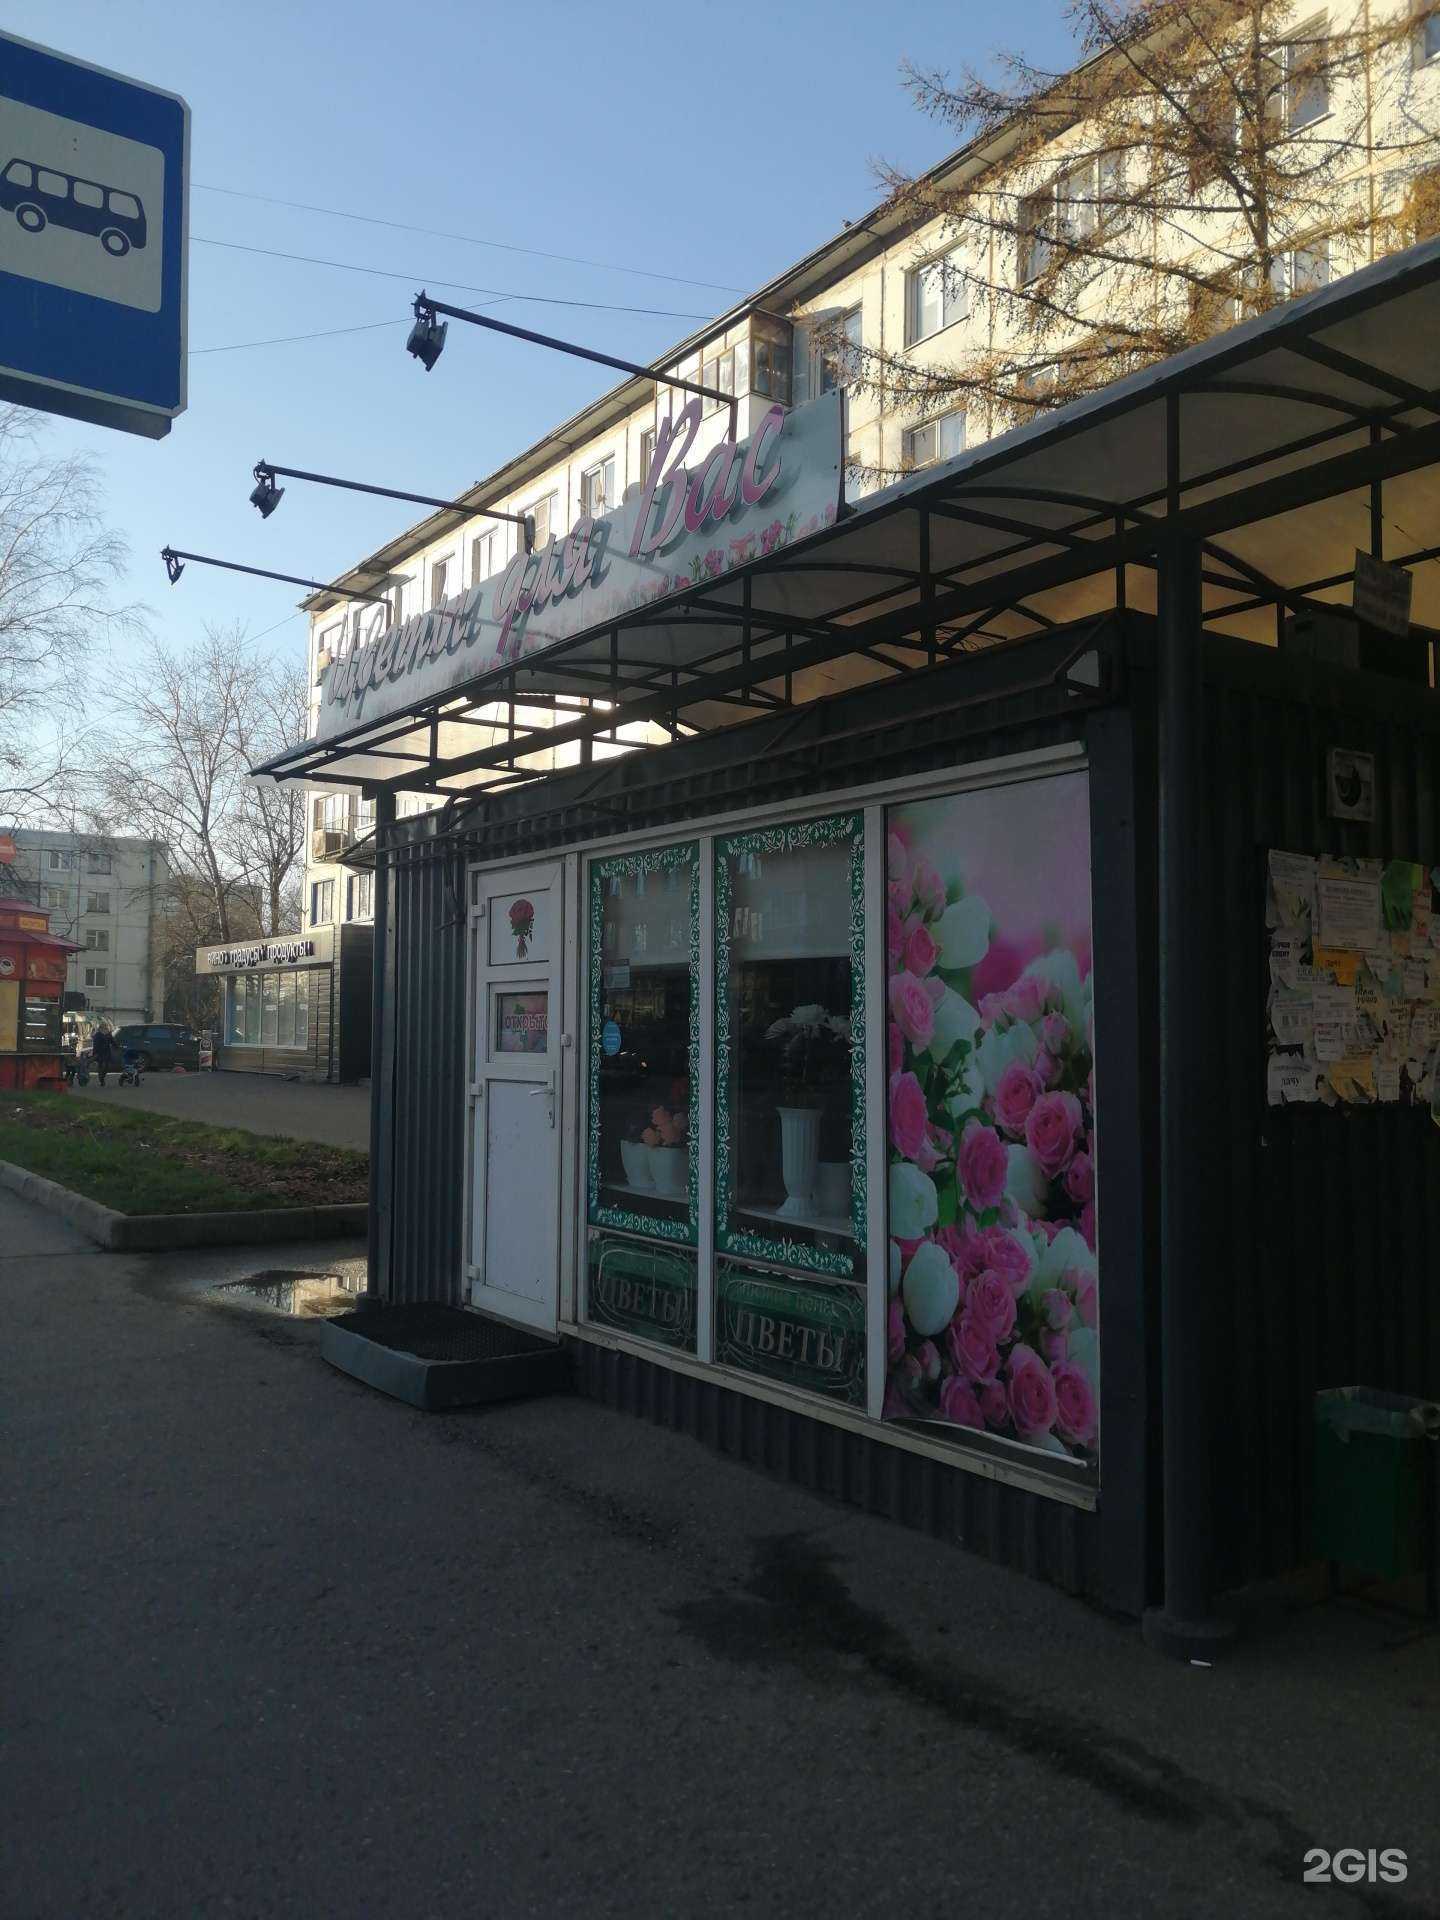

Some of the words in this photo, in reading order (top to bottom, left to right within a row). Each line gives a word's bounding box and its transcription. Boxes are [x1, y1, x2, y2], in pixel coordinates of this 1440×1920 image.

[492, 516, 596, 656] для
[629, 397, 785, 558] Вас
[735, 1310, 845, 1372] ЦВЕТЫ
